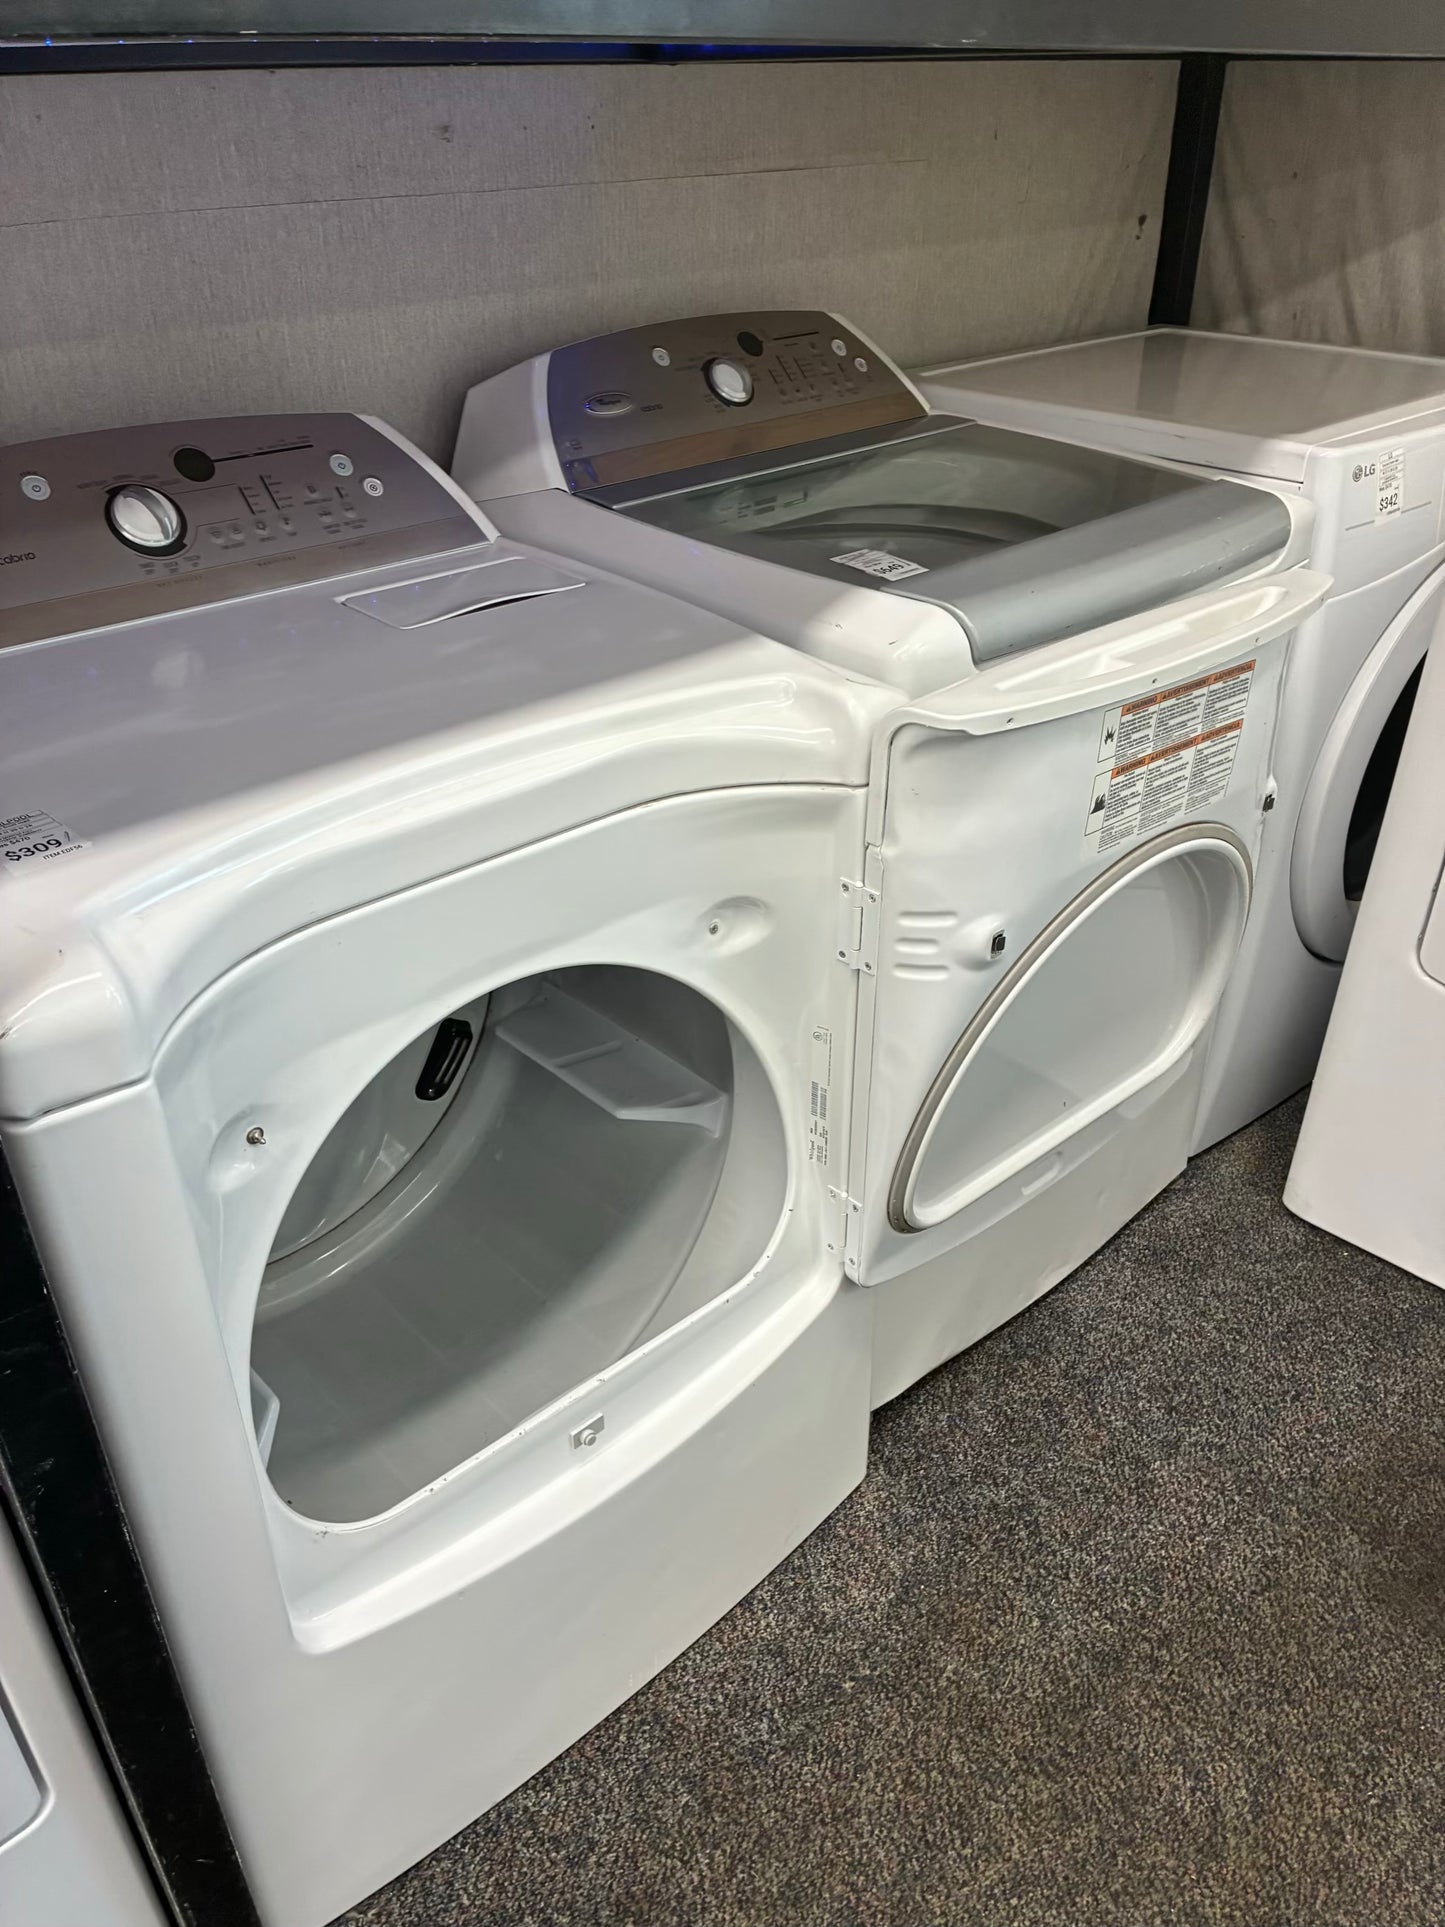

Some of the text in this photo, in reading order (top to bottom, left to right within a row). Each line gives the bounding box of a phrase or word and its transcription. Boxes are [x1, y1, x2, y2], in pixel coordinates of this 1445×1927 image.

[1363, 464, 1376, 478] LG
[1379, 493, 1398, 512] $342
[1120, 758, 1146, 772] WARNING
[4, 838, 63, 861] $309
